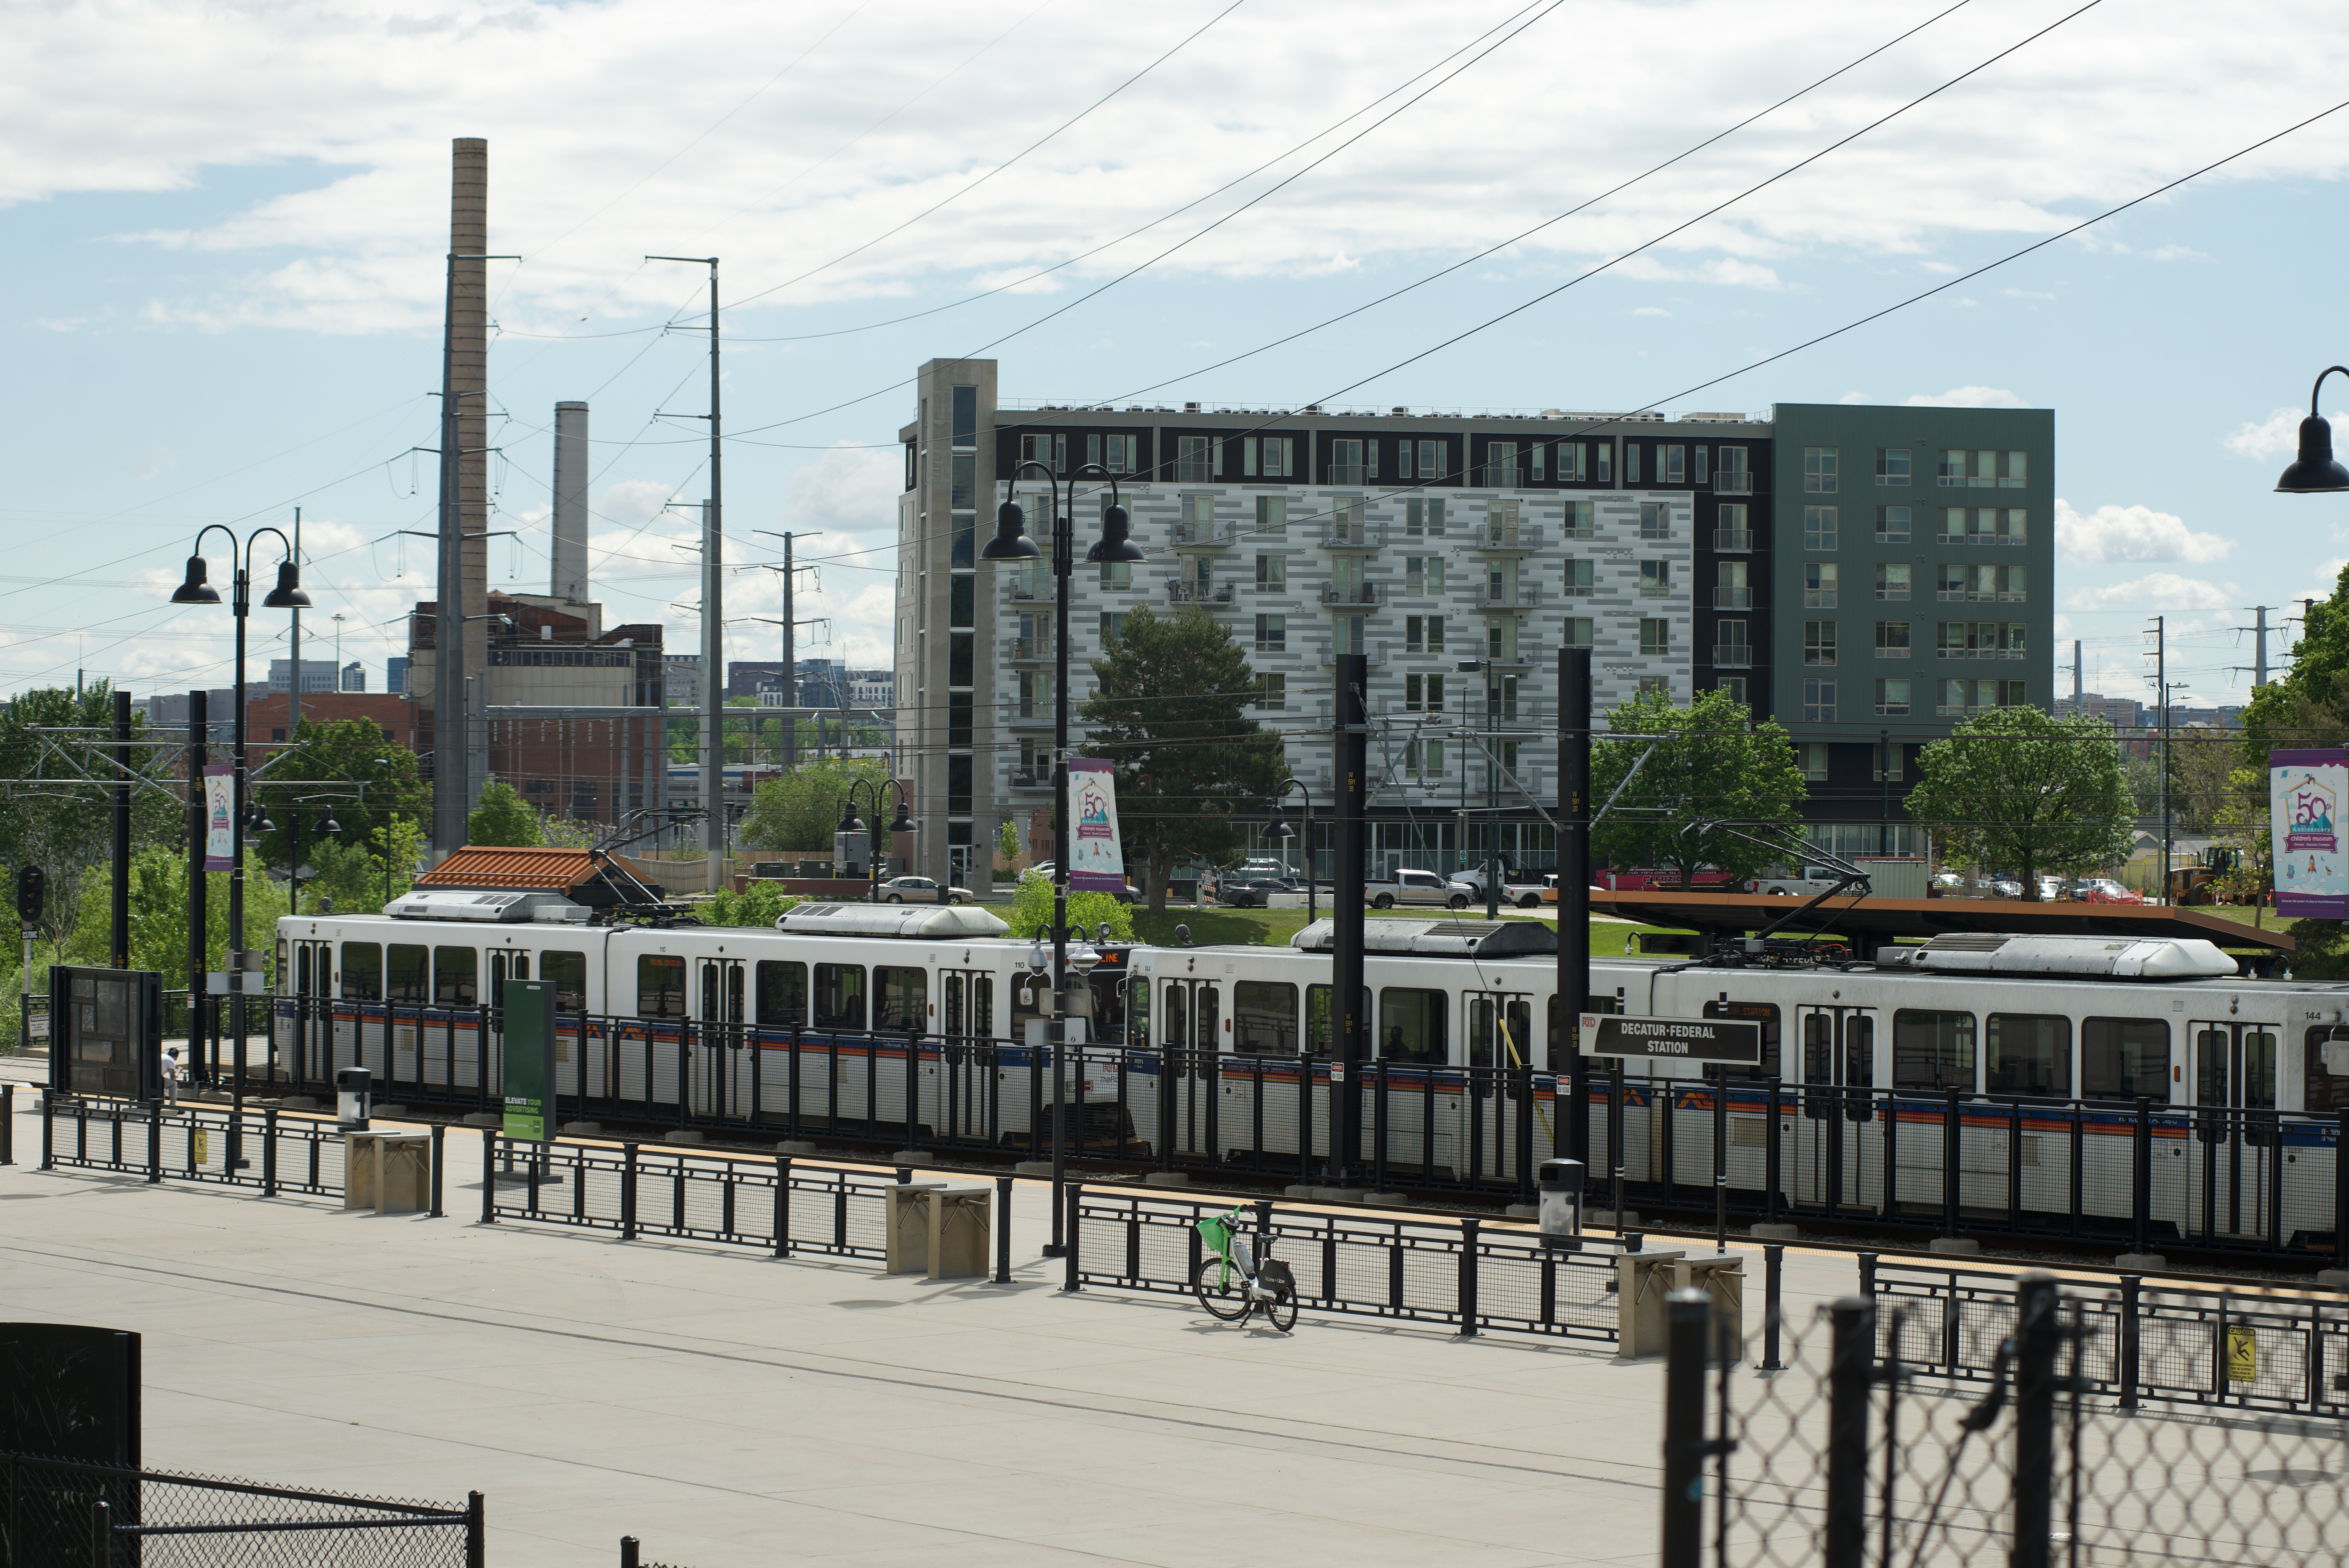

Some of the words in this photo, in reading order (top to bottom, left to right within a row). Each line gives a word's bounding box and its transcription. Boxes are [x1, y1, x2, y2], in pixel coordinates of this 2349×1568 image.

[1101, 953, 1118, 962] LINE
[1743, 1007, 1770, 1016] STATION
[2305, 1012, 2321, 1020] 144
[1582, 1017, 1595, 1027] RTD
[1647, 1040, 1688, 1053] STATION
[505, 1096, 527, 1105] ELEVATE
[505, 1105, 539, 1114] ADVERTISING
